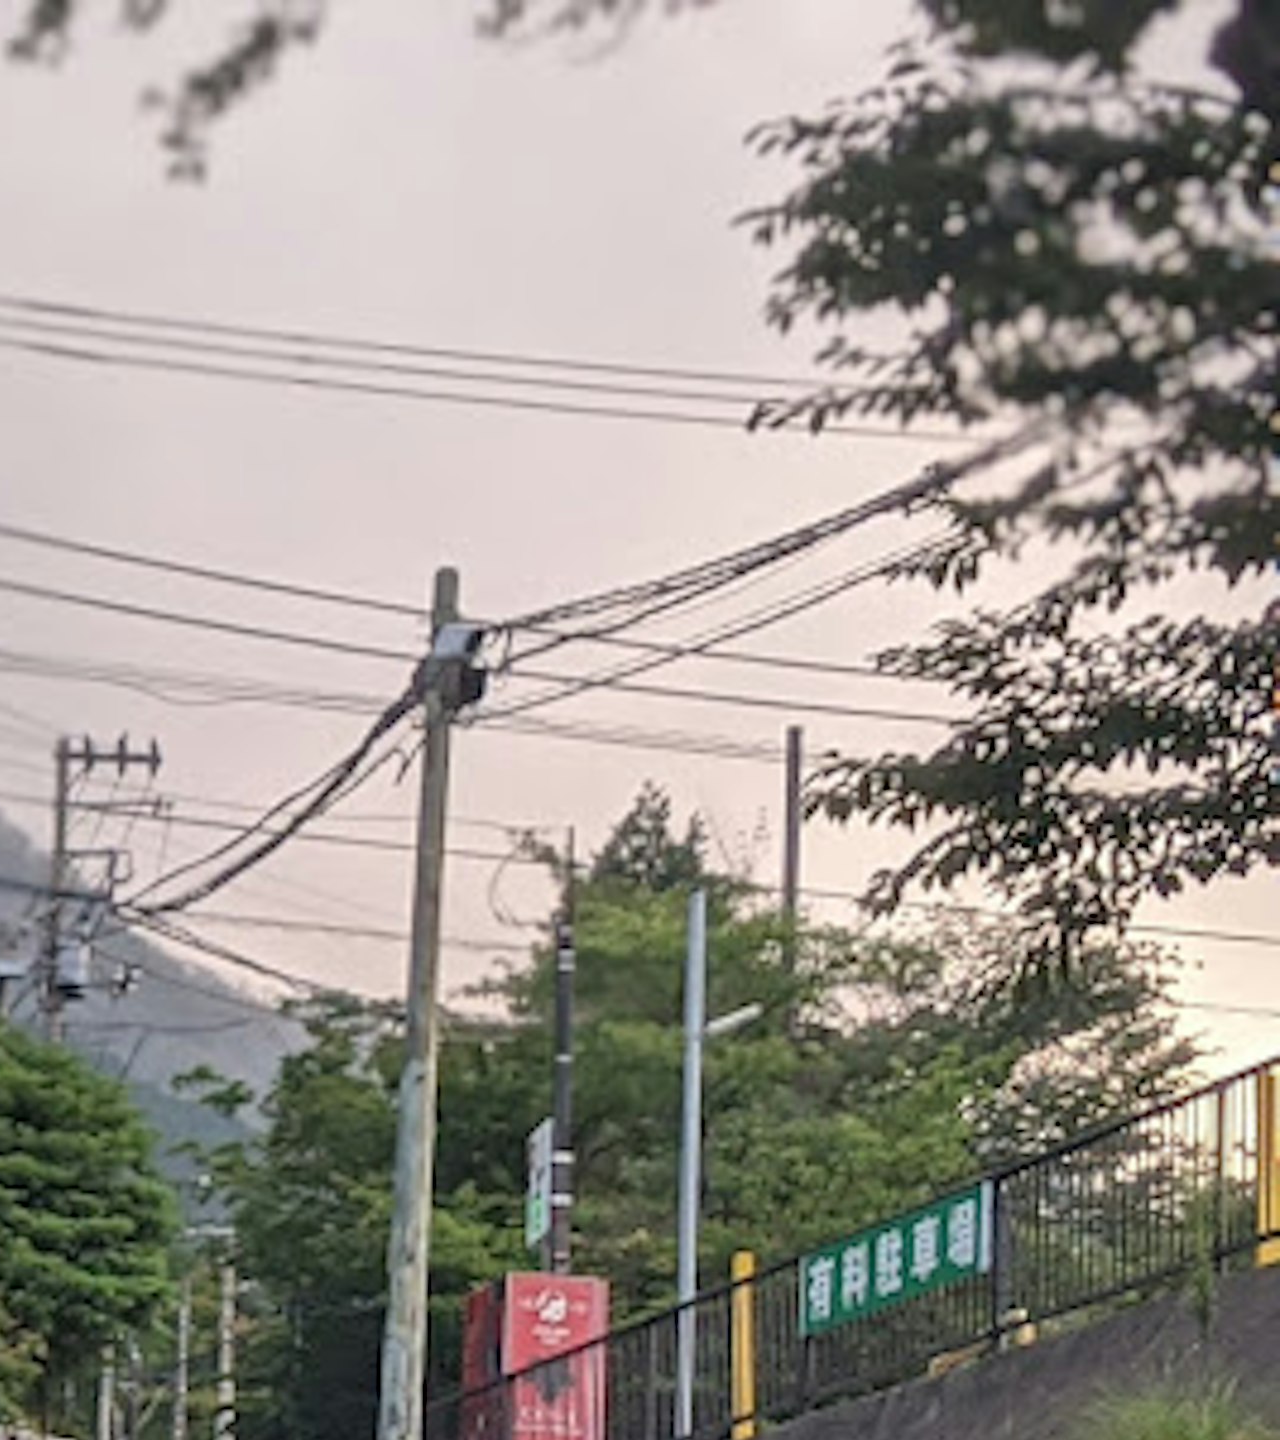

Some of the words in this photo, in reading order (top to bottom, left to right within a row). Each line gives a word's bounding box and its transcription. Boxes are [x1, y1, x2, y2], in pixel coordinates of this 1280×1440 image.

[807, 1199, 977, 1321] 有料駐車場
